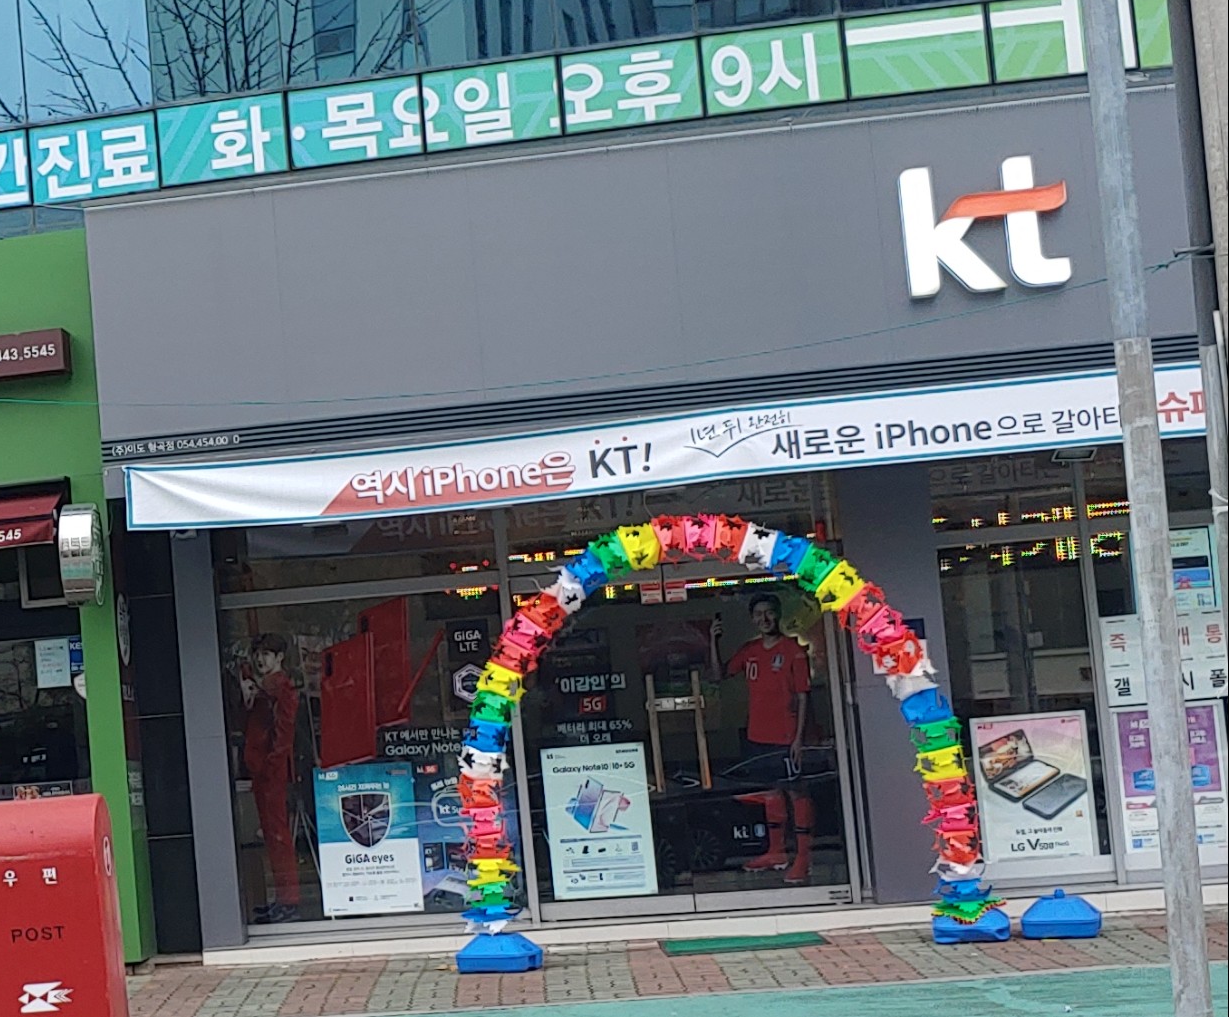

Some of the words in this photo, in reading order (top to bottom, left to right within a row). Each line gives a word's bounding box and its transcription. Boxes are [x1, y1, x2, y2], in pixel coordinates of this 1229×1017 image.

[550, 50, 681, 127] 오후
[709, 32, 820, 106] 9시
[897, 155, 1071, 299] kt
[350, 465, 416, 505] 역시
[423, 450, 576, 497] iPhone은
[588, 441, 653, 480] KT!
[690, 423, 720, 445] 1년
[722, 417, 742, 440] 뒤
[748, 410, 791, 431] 완전히
[771, 425, 865, 460] 새로운
[875, 412, 1047, 451] iPhone으로
[459, 641, 479, 652] LTE
[583, 697, 602, 711] 5G
[385, 731, 398, 743] KT
[431, 727, 460, 740] 만나는
[557, 721, 585, 734] 배터리
[385, 741, 430, 757] Galaxy
[552, 763, 582, 774] Galaxy
[1011, 842, 1025, 852] LG
[372, 852, 395, 866] eyes
[11, 926, 65, 943] POST
